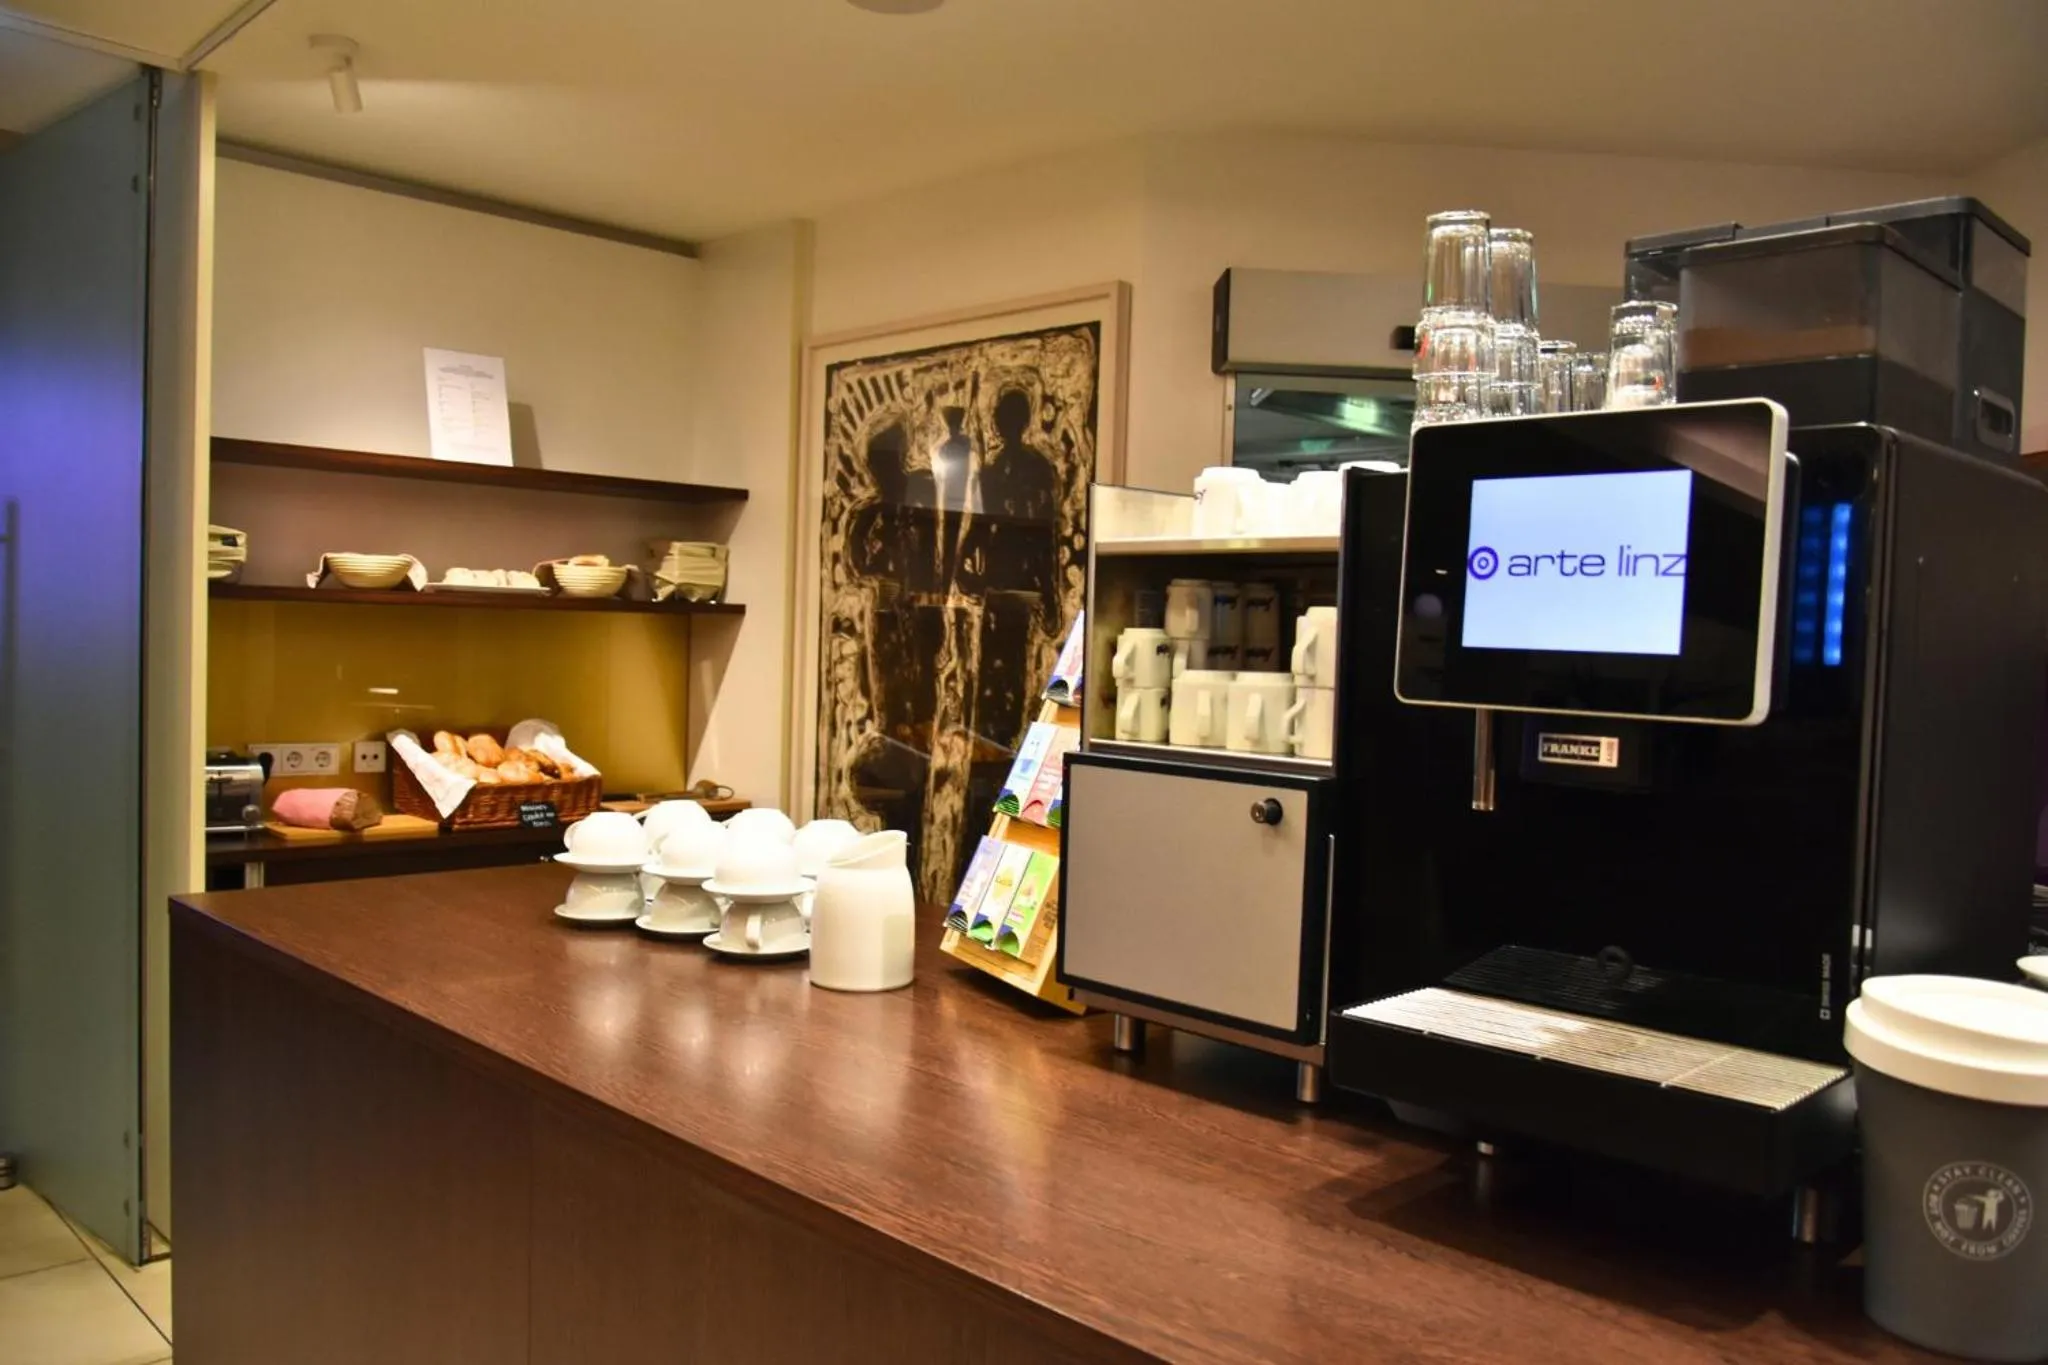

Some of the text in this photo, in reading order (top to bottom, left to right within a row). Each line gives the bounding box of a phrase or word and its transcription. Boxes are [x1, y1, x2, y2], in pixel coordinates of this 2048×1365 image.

[1507, 544, 1688, 578] arte linz
[1543, 742, 1599, 757] FRANKE
[1939, 1166, 2022, 1195] STAY CLEAN
[1960, 1240, 1997, 1256] FROM
